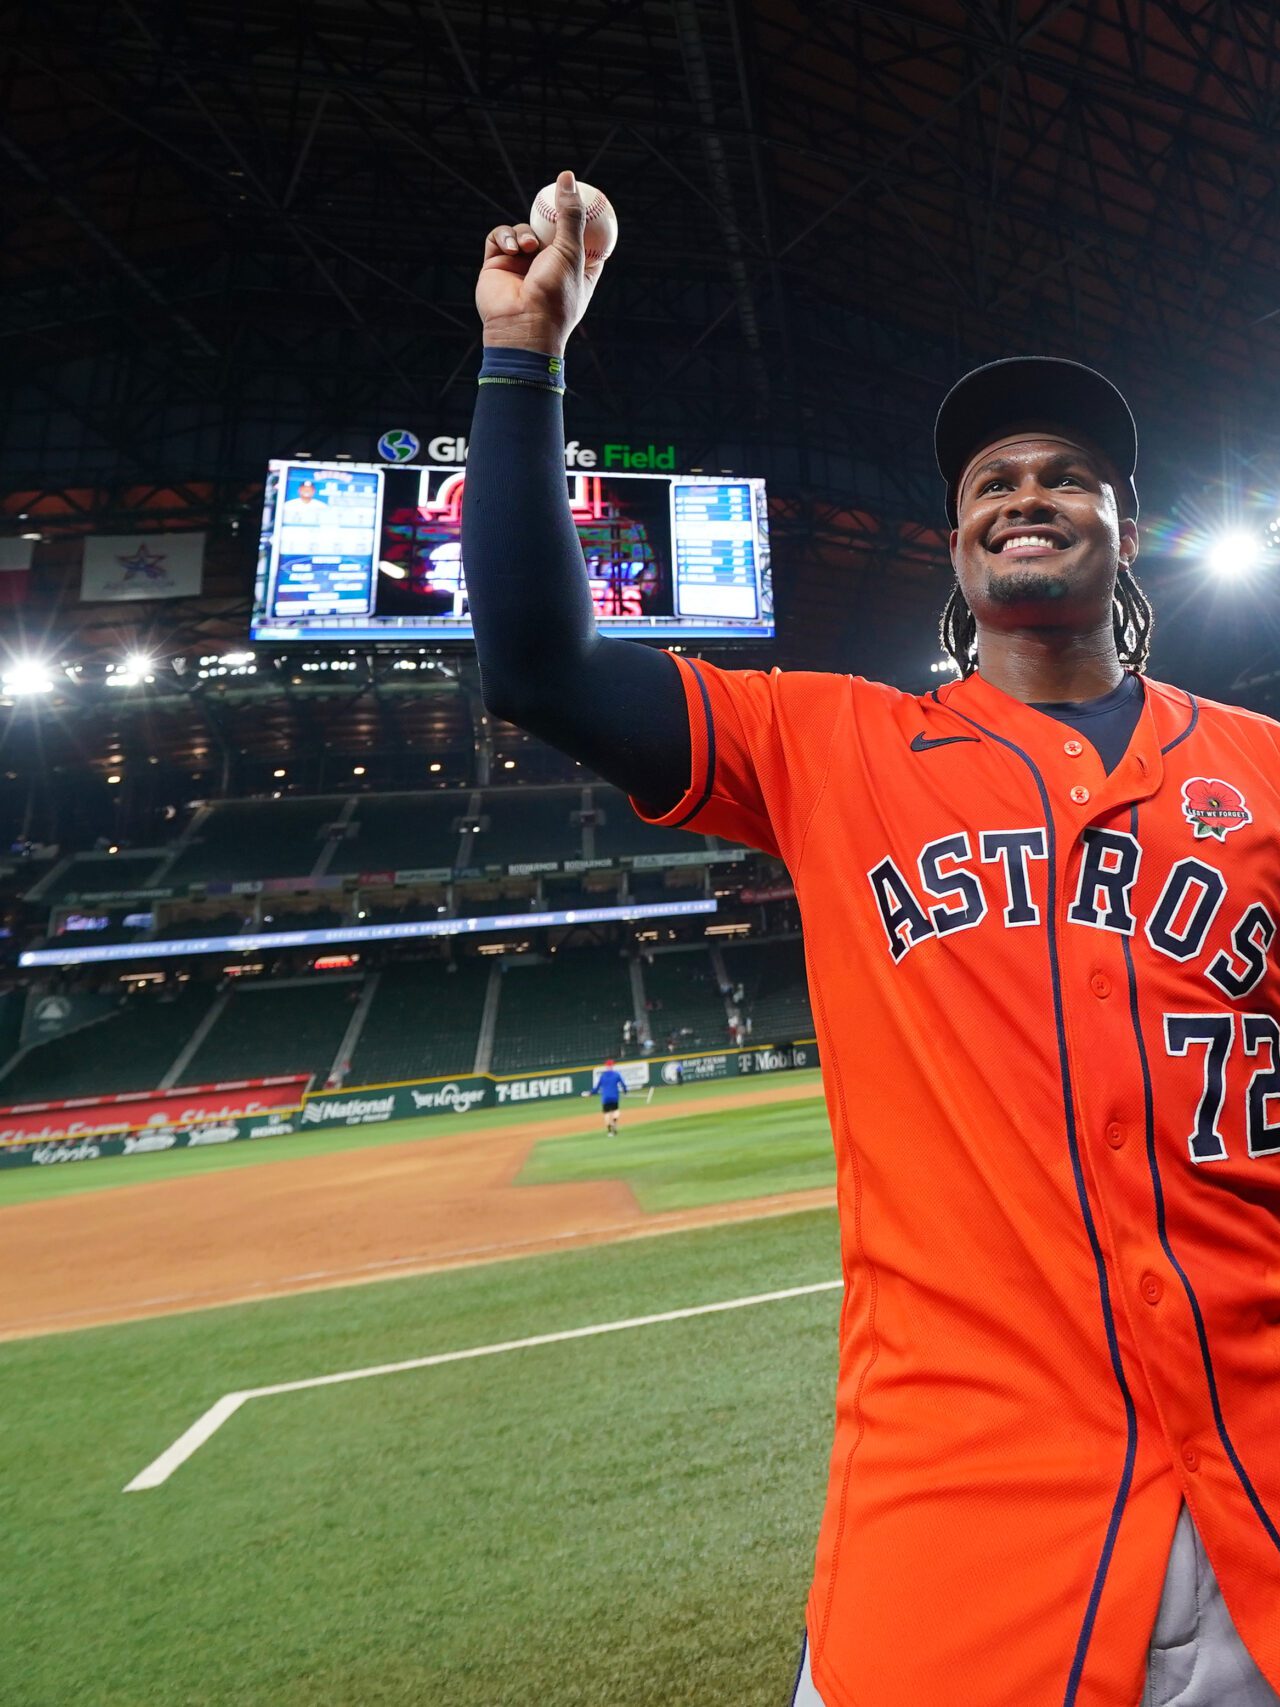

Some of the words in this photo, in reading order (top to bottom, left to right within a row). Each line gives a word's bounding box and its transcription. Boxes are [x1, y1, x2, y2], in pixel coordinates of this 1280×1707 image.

[428, 437, 470, 462] Gl
[604, 445, 675, 469] Field
[867, 826, 1277, 1000] ASTROS
[755, 1050, 806, 1071] Mobile
[323, 1095, 395, 1120] National
[434, 1083, 486, 1113] Kroger
[31, 1145, 100, 1166] Kubota
